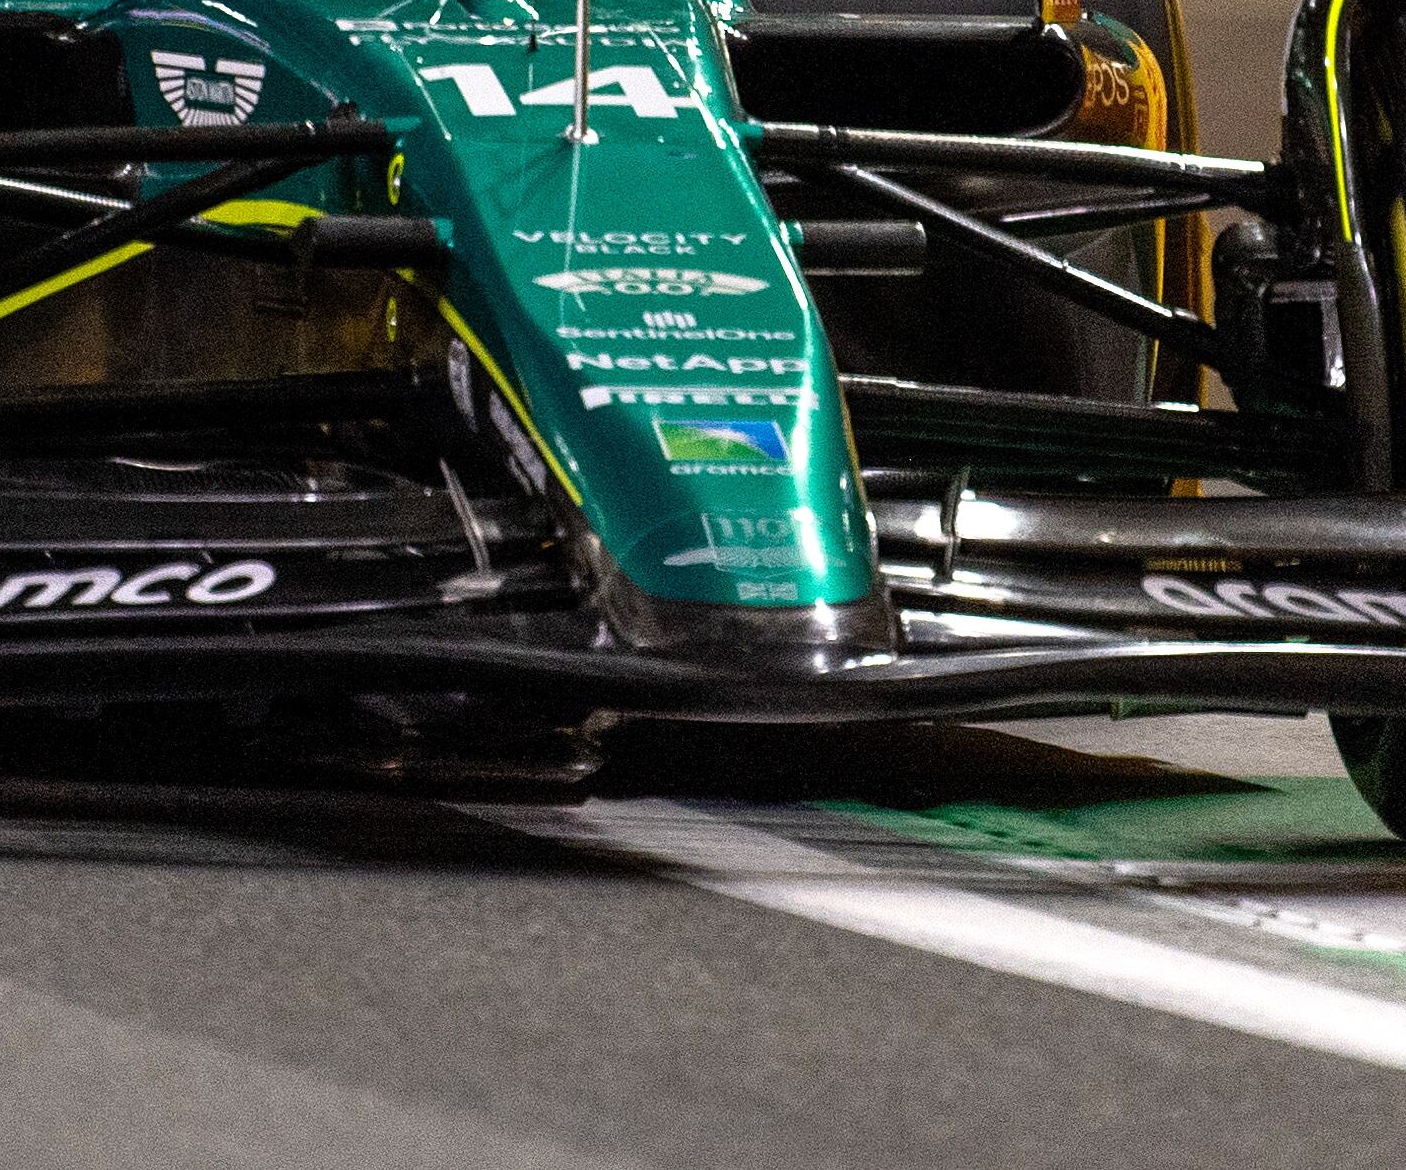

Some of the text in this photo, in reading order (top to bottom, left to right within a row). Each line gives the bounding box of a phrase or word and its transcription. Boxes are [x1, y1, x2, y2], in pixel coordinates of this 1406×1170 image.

[418, 63, 693, 119] 14
[512, 230, 746, 245] VELOCITY
[566, 352, 811, 375] NetApp
